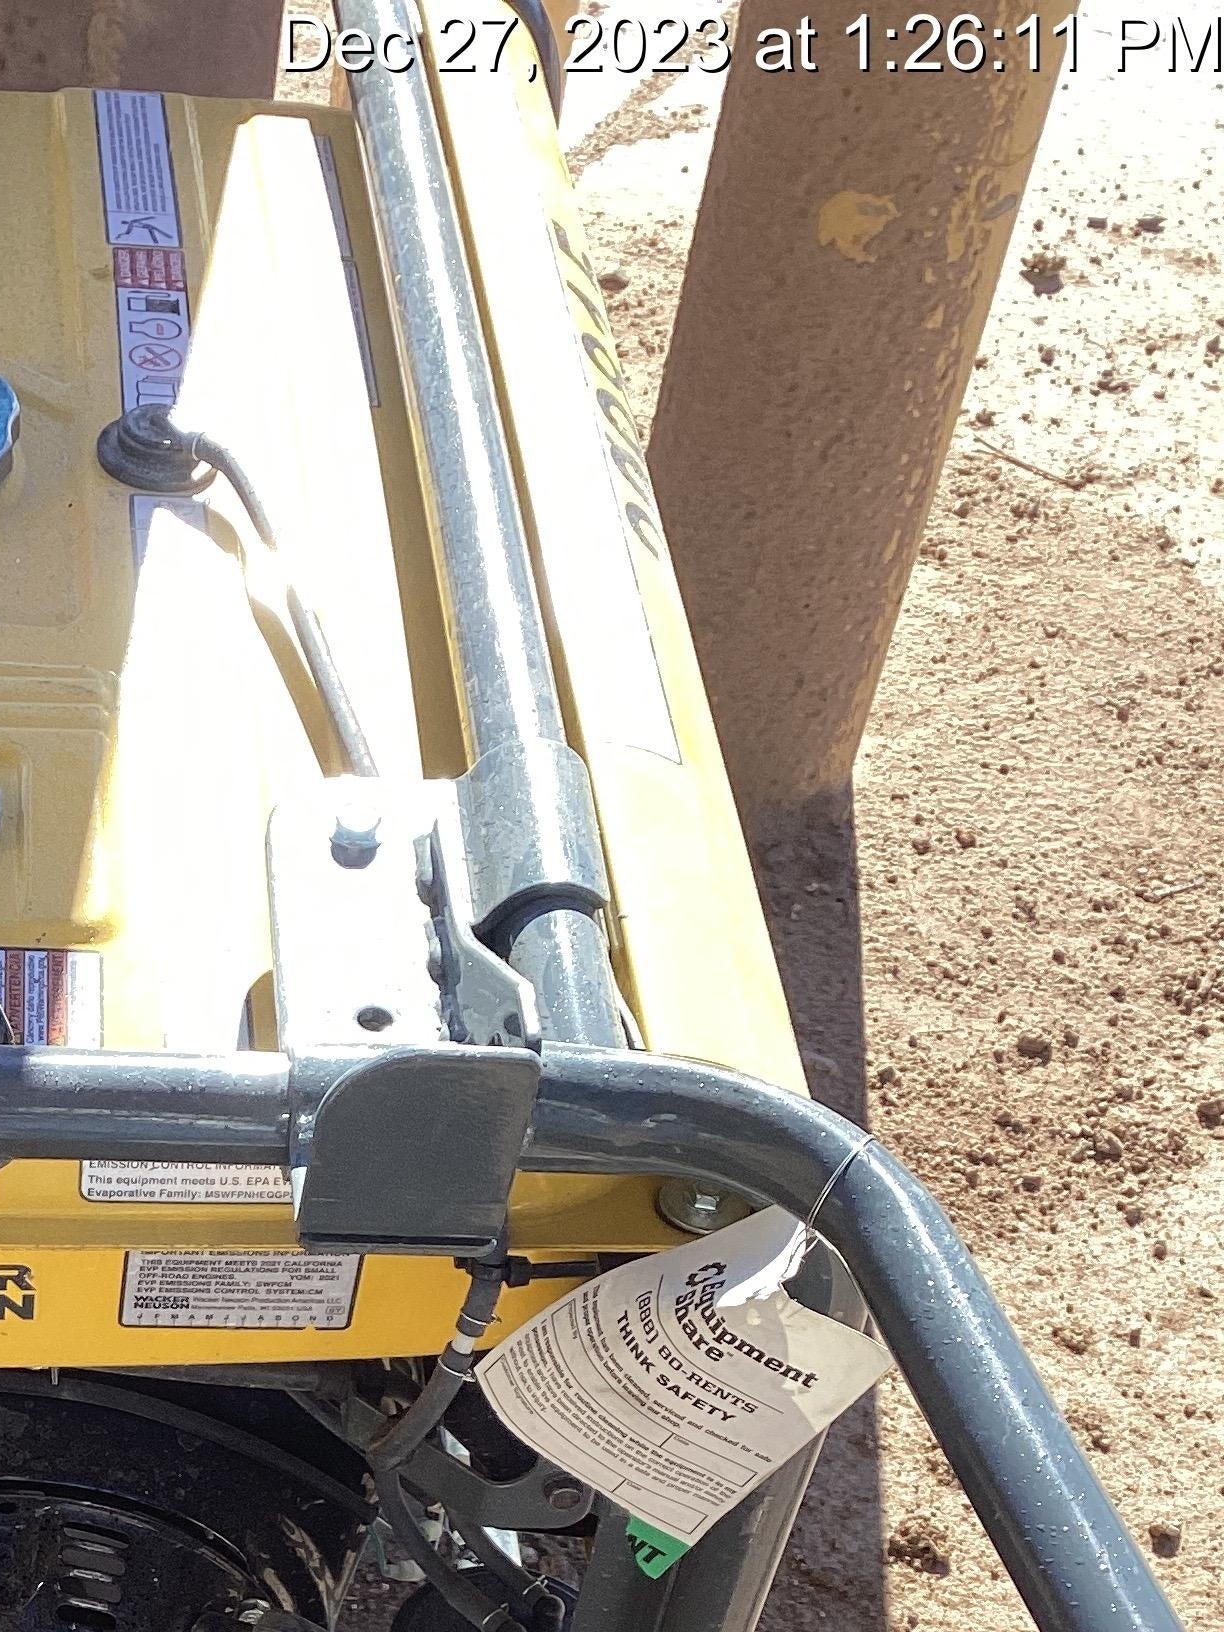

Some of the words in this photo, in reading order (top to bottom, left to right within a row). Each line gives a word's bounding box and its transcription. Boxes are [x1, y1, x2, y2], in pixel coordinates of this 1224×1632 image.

[87, 1188, 155, 1198] Evaporative
[159, 1189, 201, 1200] Family:
[88, 1175, 112, 1184] This
[116, 1176, 177, 1186] equipment
[181, 1177, 215, 1185] meets
[220, 1177, 241, 1185] U.S.
[247, 1177, 270, 1185] EPA
[586, 1327, 604, 1362] operation
[603, 1361, 623, 1385] before
[621, 1384, 646, 1407] leaving
[647, 1405, 660, 1416] our
[661, 1413, 681, 1429] shop.
[616, 1310, 656, 1374] THINK
[656, 1373, 737, 1422] SAFETY
[635, 1290, 659, 1344] (888)
[658, 1344, 759, 1414] 80-RENTS
[675, 1289, 725, 1362] Share
[695, 1279, 819, 1389] Equipment
[542, 1333, 565, 1378] responsible
[563, 1377, 574, 1390] for
[575, 1392, 598, 1414] routine
[598, 1413, 628, 1438] cleaning
[629, 1436, 650, 1451] while
[651, 1450, 663, 1458] the
[664, 1457, 707, 1478] equipment
[549, 1373, 562, 1390] have
[561, 1389, 586, 1415] received
[600, 1338, 610, 1353] has
[609, 1353, 624, 1373] been
[624, 1373, 650, 1401] cleaned,
[653, 1399, 687, 1422] serviced
[687, 1420, 704, 1431] and
[704, 1428, 740, 1447] checked
[740, 1444, 754, 1453] for
